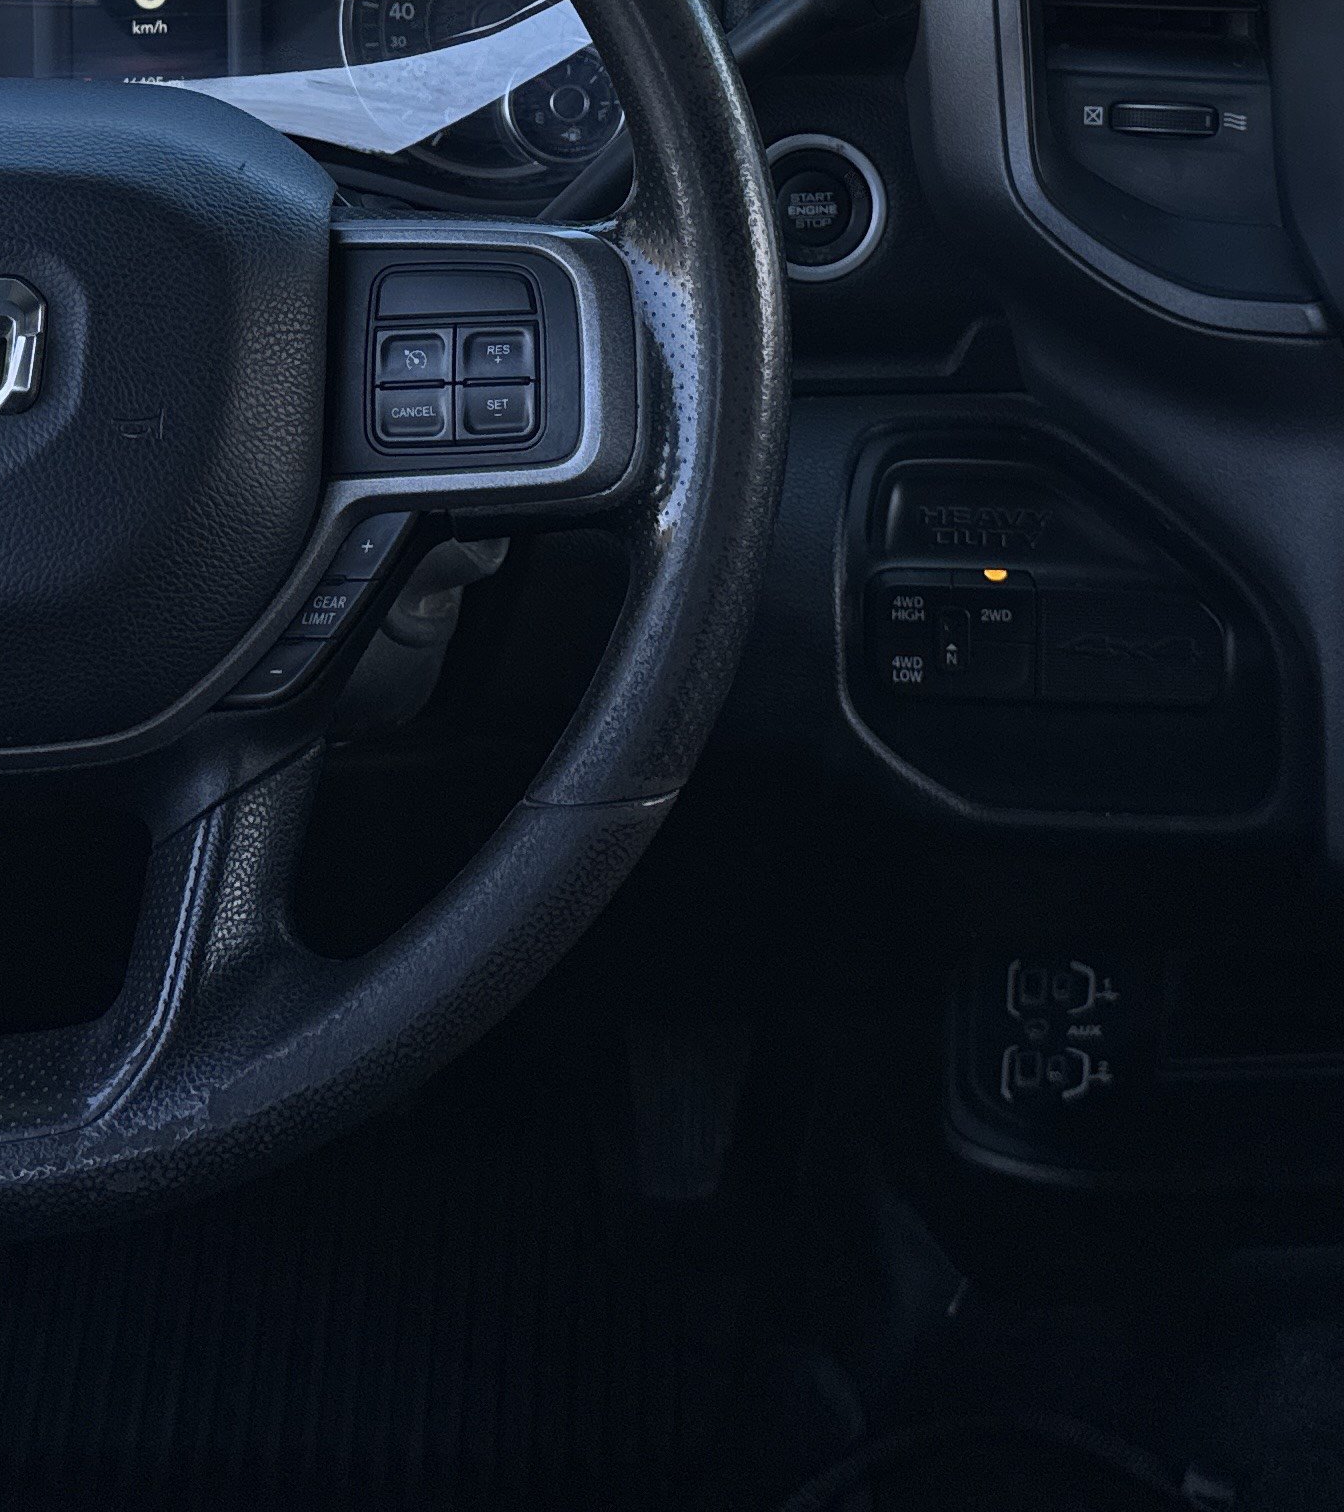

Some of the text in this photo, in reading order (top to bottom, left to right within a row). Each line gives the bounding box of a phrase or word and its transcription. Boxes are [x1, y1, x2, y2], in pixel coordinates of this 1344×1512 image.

[389, 2, 415, 21] 40
[132, 20, 167, 35] km/h
[390, 37, 407, 48] 30
[790, 192, 834, 203] START
[787, 204, 838, 216] ENGINE
[795, 217, 832, 229] STOP
[487, 345, 511, 356] RES
[486, 398, 509, 410] SET
[391, 407, 436, 418] CANCEL
[920, 506, 1054, 527] HEAVY
[313, 595, 347, 609] GEAR
[892, 596, 924, 608] 4WD
[302, 612, 336, 626] LIMIT
[891, 608, 925, 623] HIGH
[980, 609, 1012, 623] 2WD
[892, 656, 923, 669] 4WD
[946, 652, 957, 665] N
[892, 669, 924, 683] LOW
[1067, 1025, 1103, 1037] AUX
